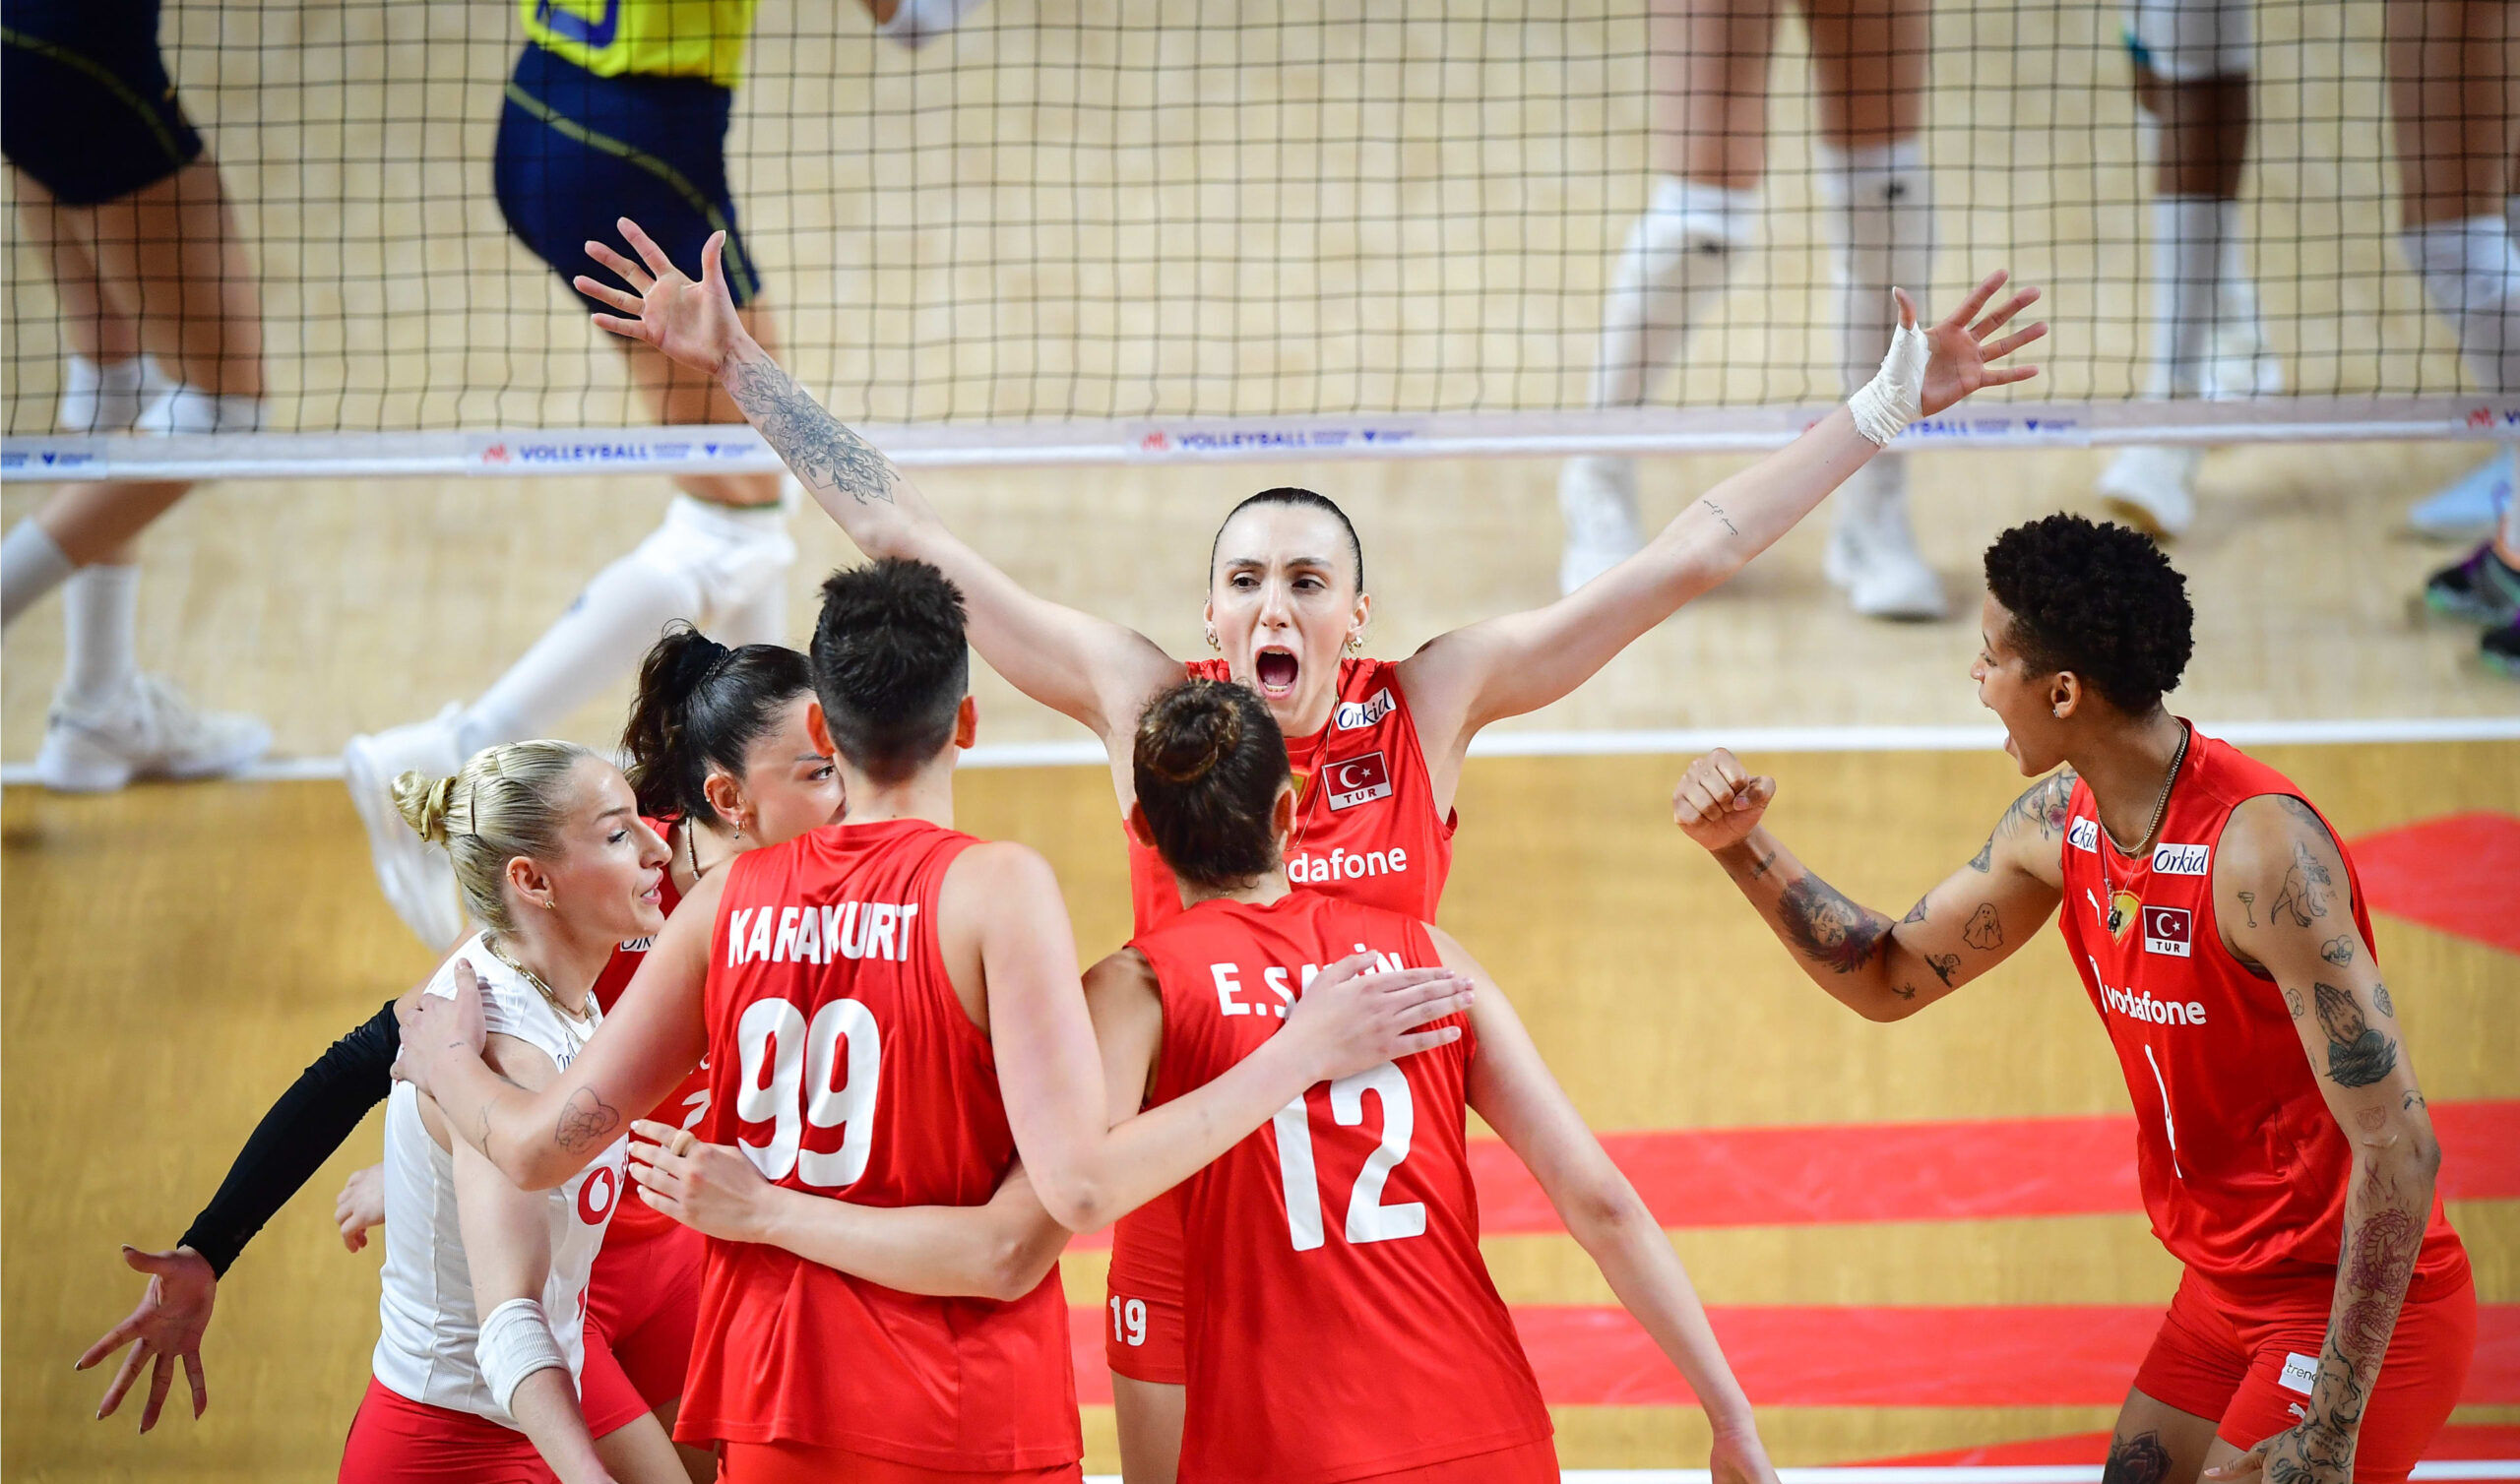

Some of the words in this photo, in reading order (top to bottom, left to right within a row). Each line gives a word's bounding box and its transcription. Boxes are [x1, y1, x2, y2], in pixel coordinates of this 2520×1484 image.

[520, 444, 647, 462] VOLLEYBALL
[1178, 431, 1306, 448] VOLLEYBALL
[1338, 690, 1390, 729] Orkid
[1344, 787, 1378, 804] TUR
[1284, 847, 1408, 883] dafone
[2154, 849, 2206, 874] Orkid
[2156, 941, 2181, 954] TUR
[2105, 984, 2208, 1025] vodafone
[737, 997, 882, 1187] 99
[1273, 1060, 1427, 1252] 12
[1109, 1295, 1147, 1346] 19
